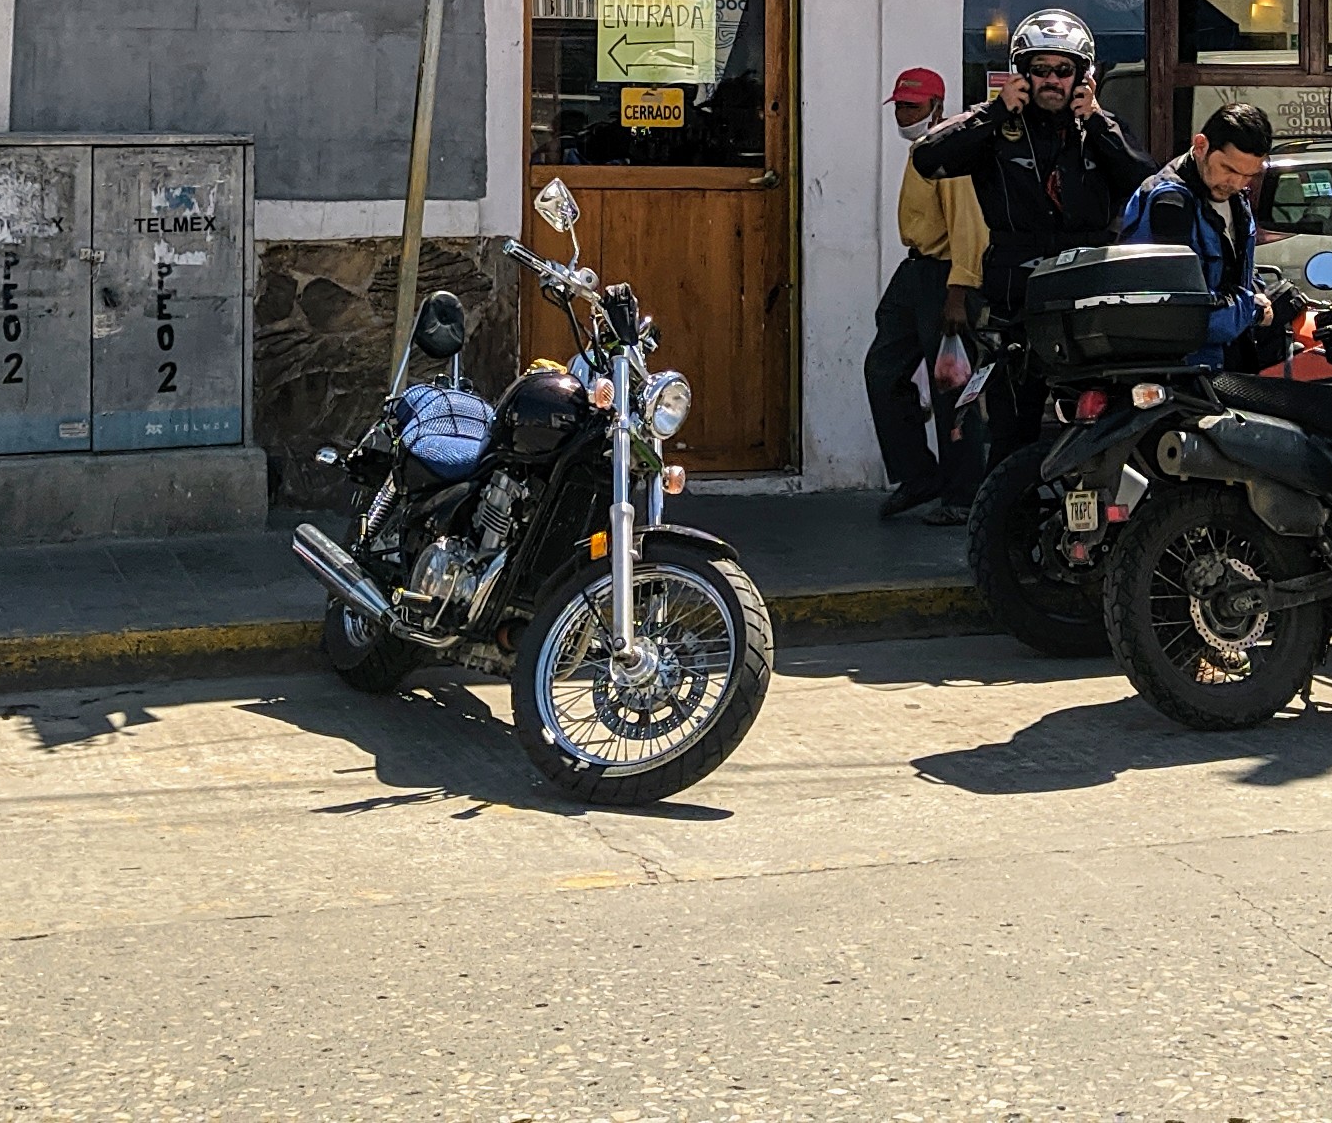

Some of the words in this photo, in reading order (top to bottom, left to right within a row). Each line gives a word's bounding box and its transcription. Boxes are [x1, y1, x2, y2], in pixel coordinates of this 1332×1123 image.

[603, 3, 704, 29] ENTRADA
[623, 104, 682, 121] CERRADO
[134, 216, 217, 233] TELMEX
